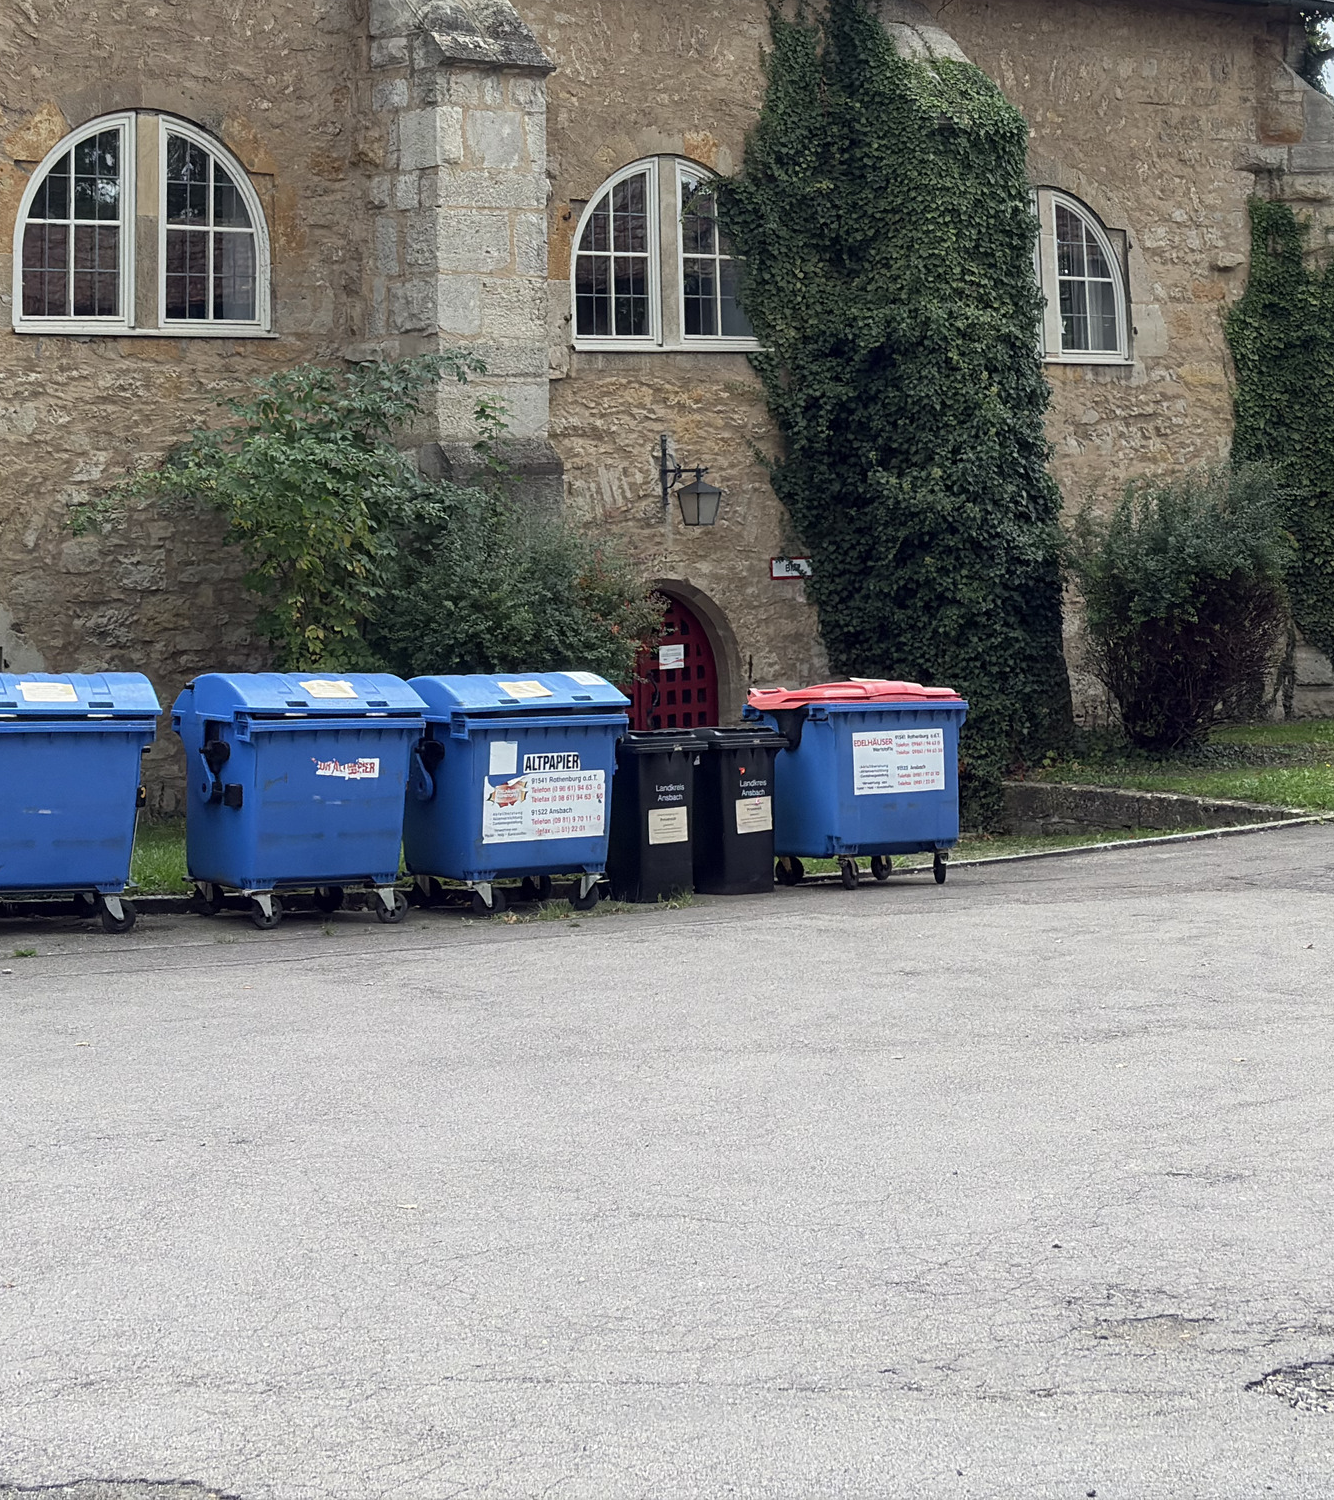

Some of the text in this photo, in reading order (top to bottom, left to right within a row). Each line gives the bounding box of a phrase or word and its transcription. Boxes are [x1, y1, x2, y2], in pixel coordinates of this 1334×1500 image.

[853, 738, 893, 747] EDELHÄUSER
[525, 754, 579, 771] ALTPAPIER
[655, 784, 685, 792] Landkreis
[657, 793, 683, 801] Ansbach
